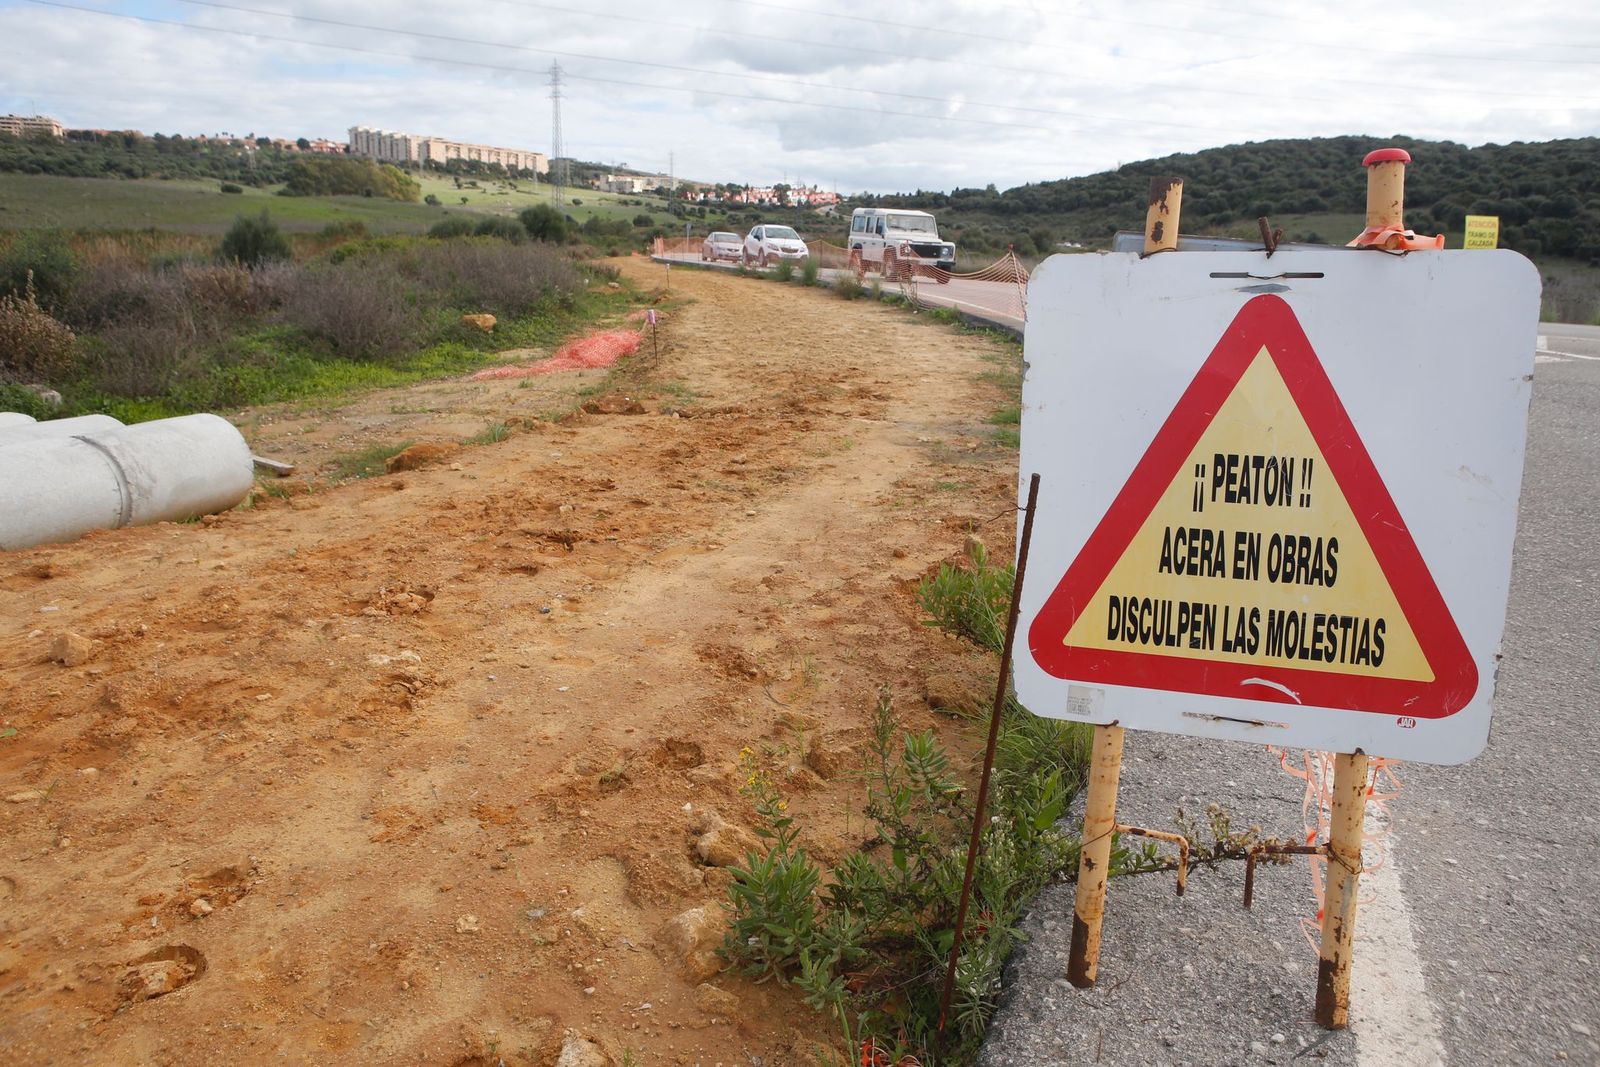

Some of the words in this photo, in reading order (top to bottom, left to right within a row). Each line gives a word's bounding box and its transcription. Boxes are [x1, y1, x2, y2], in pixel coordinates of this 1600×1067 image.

[1467, 239, 1494, 247] CALZADA
[1488, 231, 1496, 239] DE
[1158, 526, 1226, 579] ACERA
[1232, 531, 1262, 581] EN
[1266, 532, 1339, 588] OBRAS
[1107, 595, 1217, 651] DISCULPEN
[1221, 605, 1261, 656] LAS
[1265, 609, 1386, 668] MOLESTIAS
